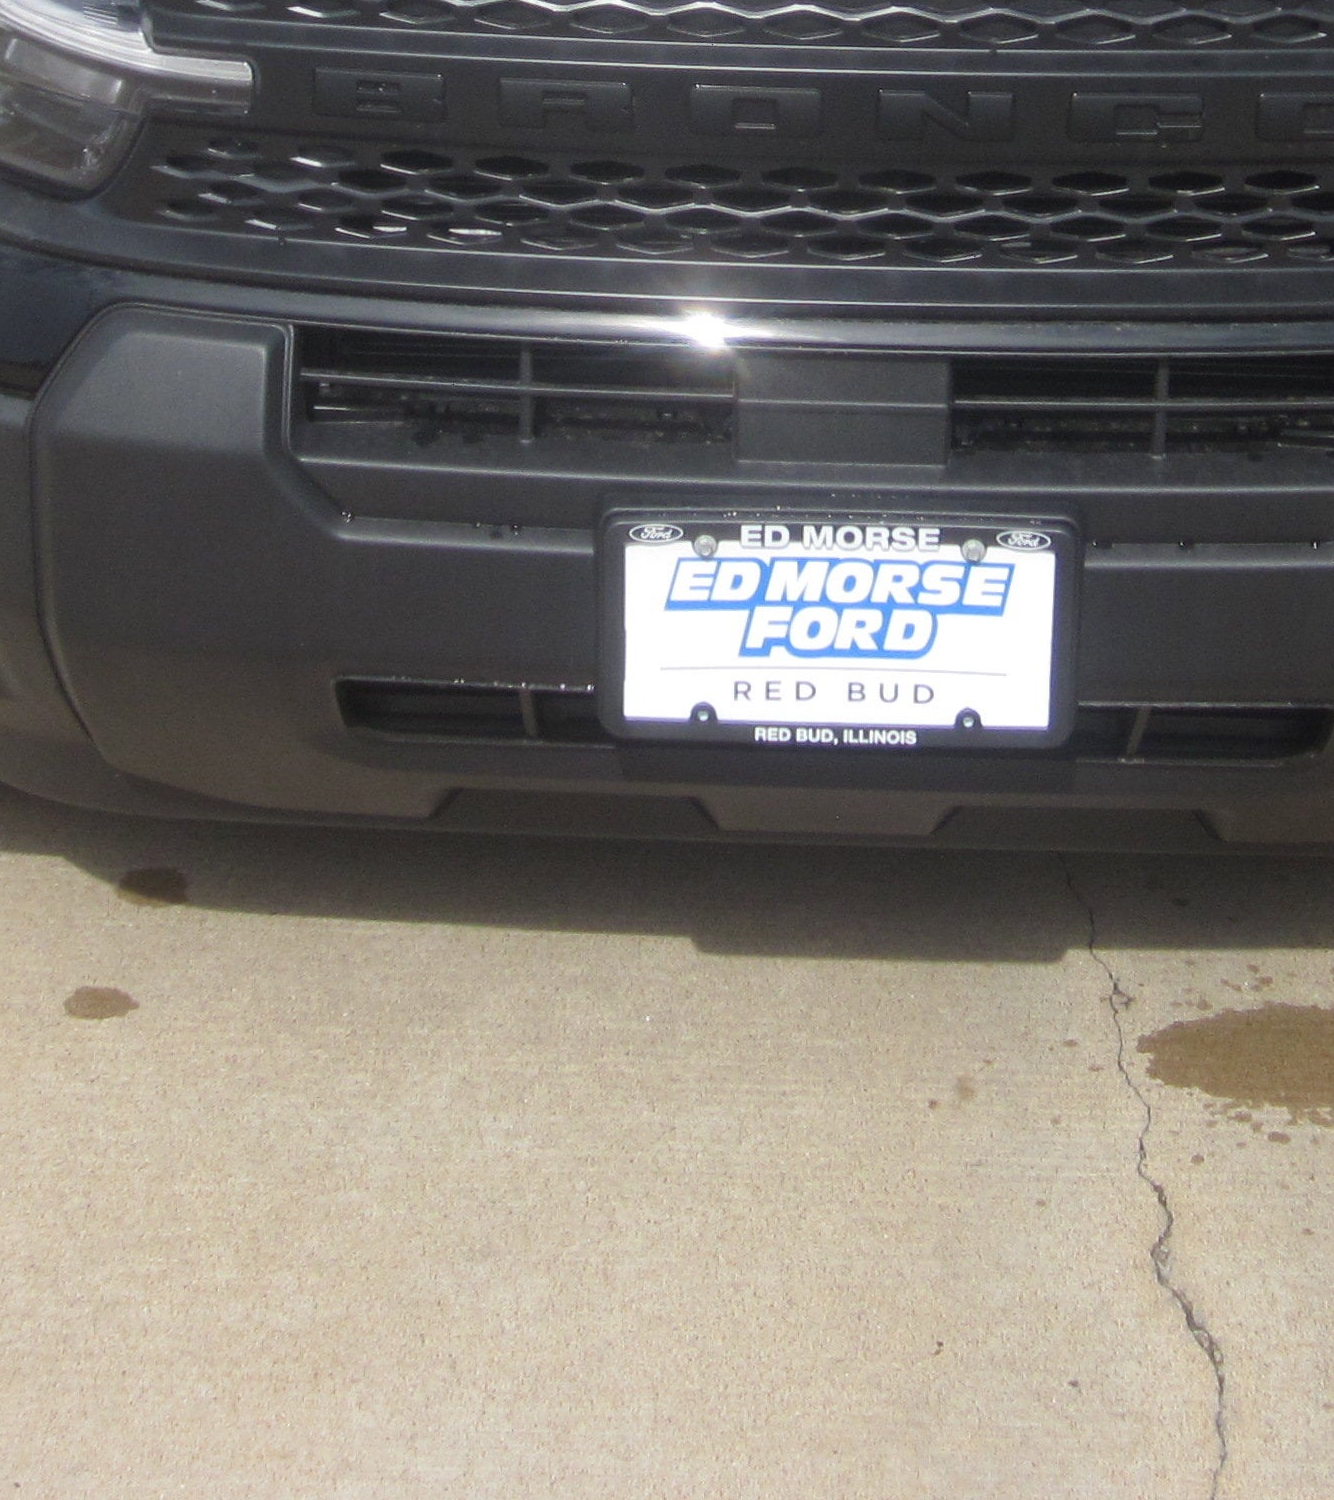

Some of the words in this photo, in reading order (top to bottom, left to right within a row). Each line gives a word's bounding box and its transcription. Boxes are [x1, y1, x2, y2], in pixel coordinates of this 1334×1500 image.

[740, 525, 791, 549] ED
[802, 526, 941, 552] MORSE
[668, 558, 762, 605] ED
[763, 558, 1011, 609] MORSE
[741, 604, 937, 655] FORD
[733, 680, 817, 702] RED
[847, 682, 935, 705] BUD
[754, 726, 791, 743] RED
[795, 727, 839, 746] BUD,
[843, 728, 918, 745] ILLINOIS
